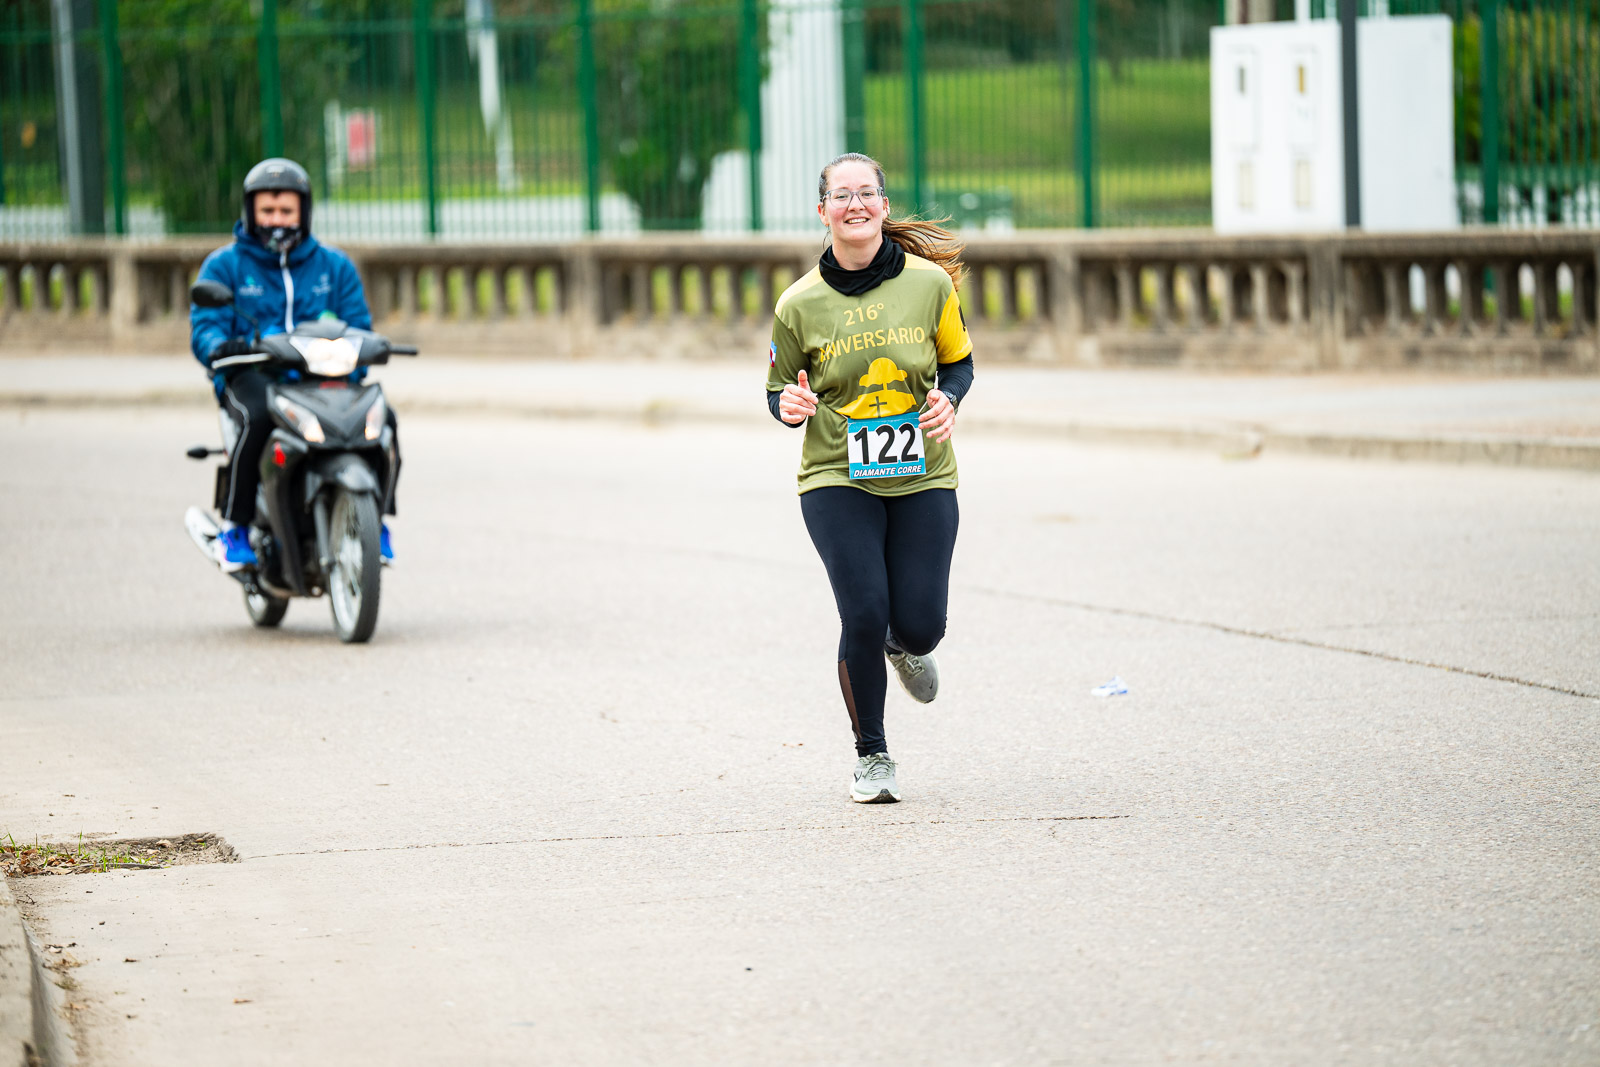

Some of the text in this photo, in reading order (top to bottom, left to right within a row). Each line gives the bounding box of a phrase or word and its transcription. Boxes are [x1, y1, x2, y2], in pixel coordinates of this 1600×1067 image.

[853, 422, 920, 466] 122
[853, 465, 922, 478] DIAMANTE CORRE
